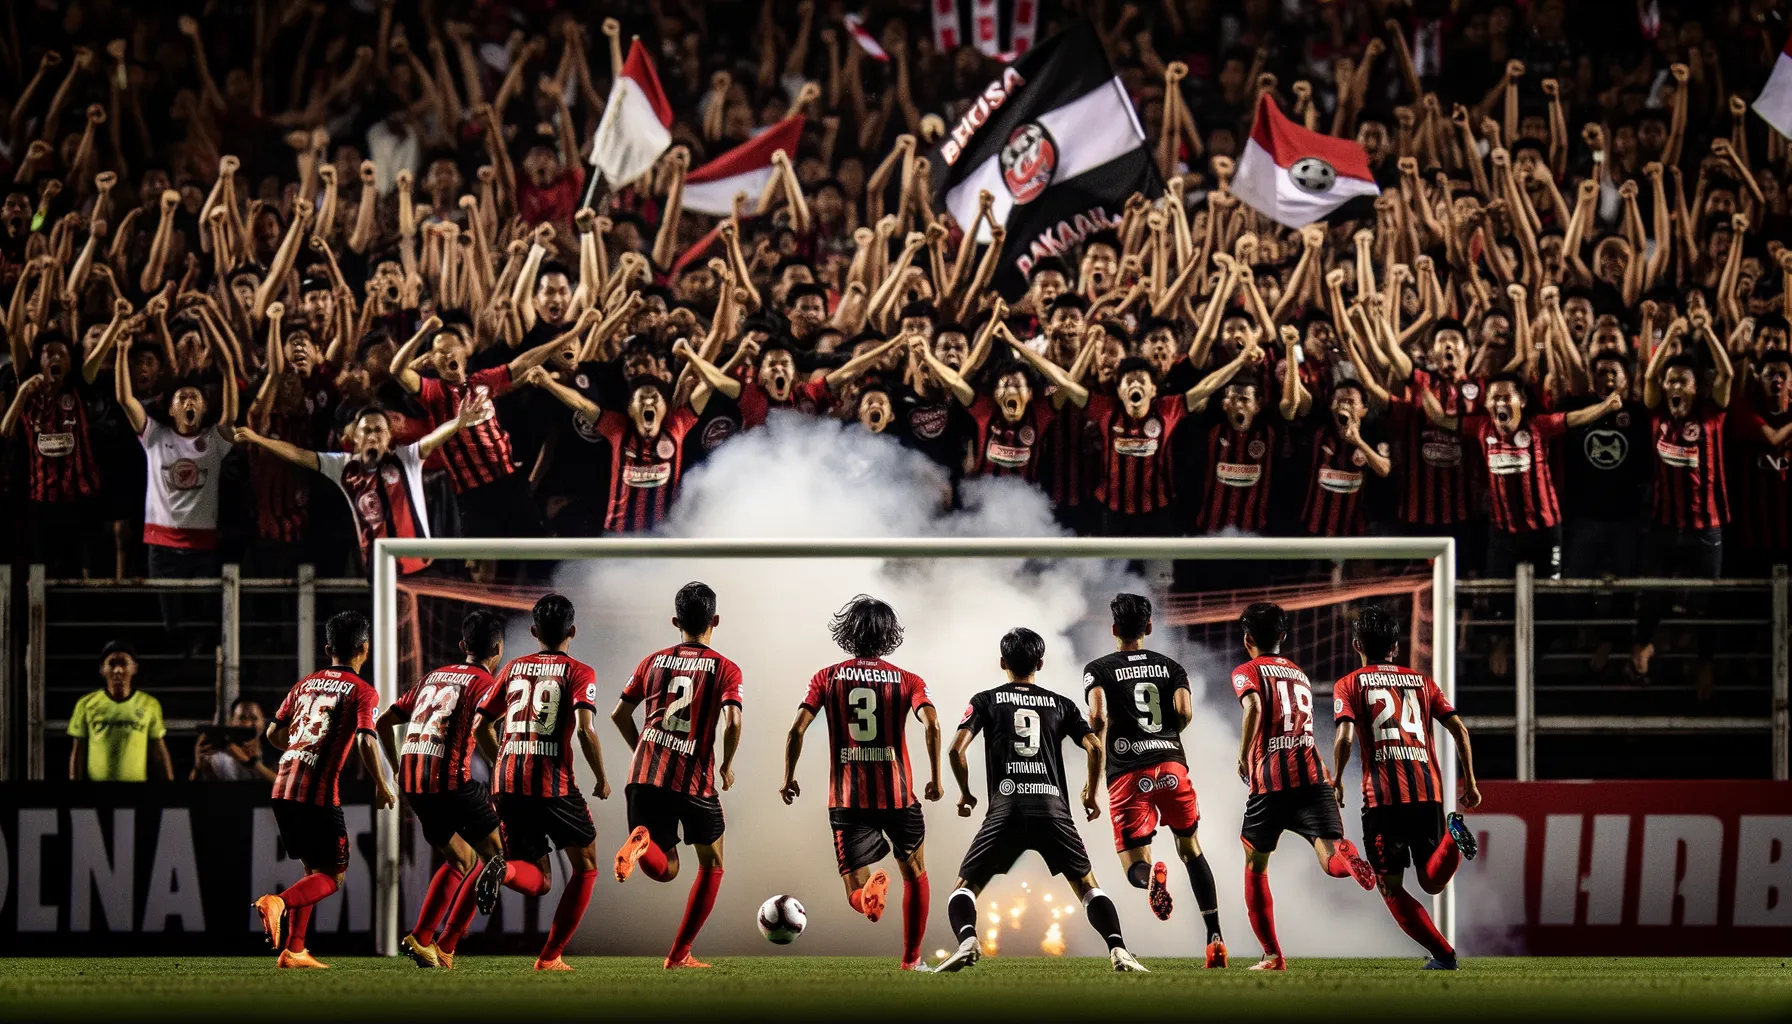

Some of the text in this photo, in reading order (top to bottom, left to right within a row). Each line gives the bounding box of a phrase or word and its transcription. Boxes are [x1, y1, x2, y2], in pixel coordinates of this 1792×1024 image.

[507, 679, 561, 735] 29
[662, 676, 694, 733] 2
[848, 687, 877, 742] 3
[1134, 682, 1162, 734] 9
[1368, 688, 1425, 746] 24
[1014, 708, 1040, 757] 9
